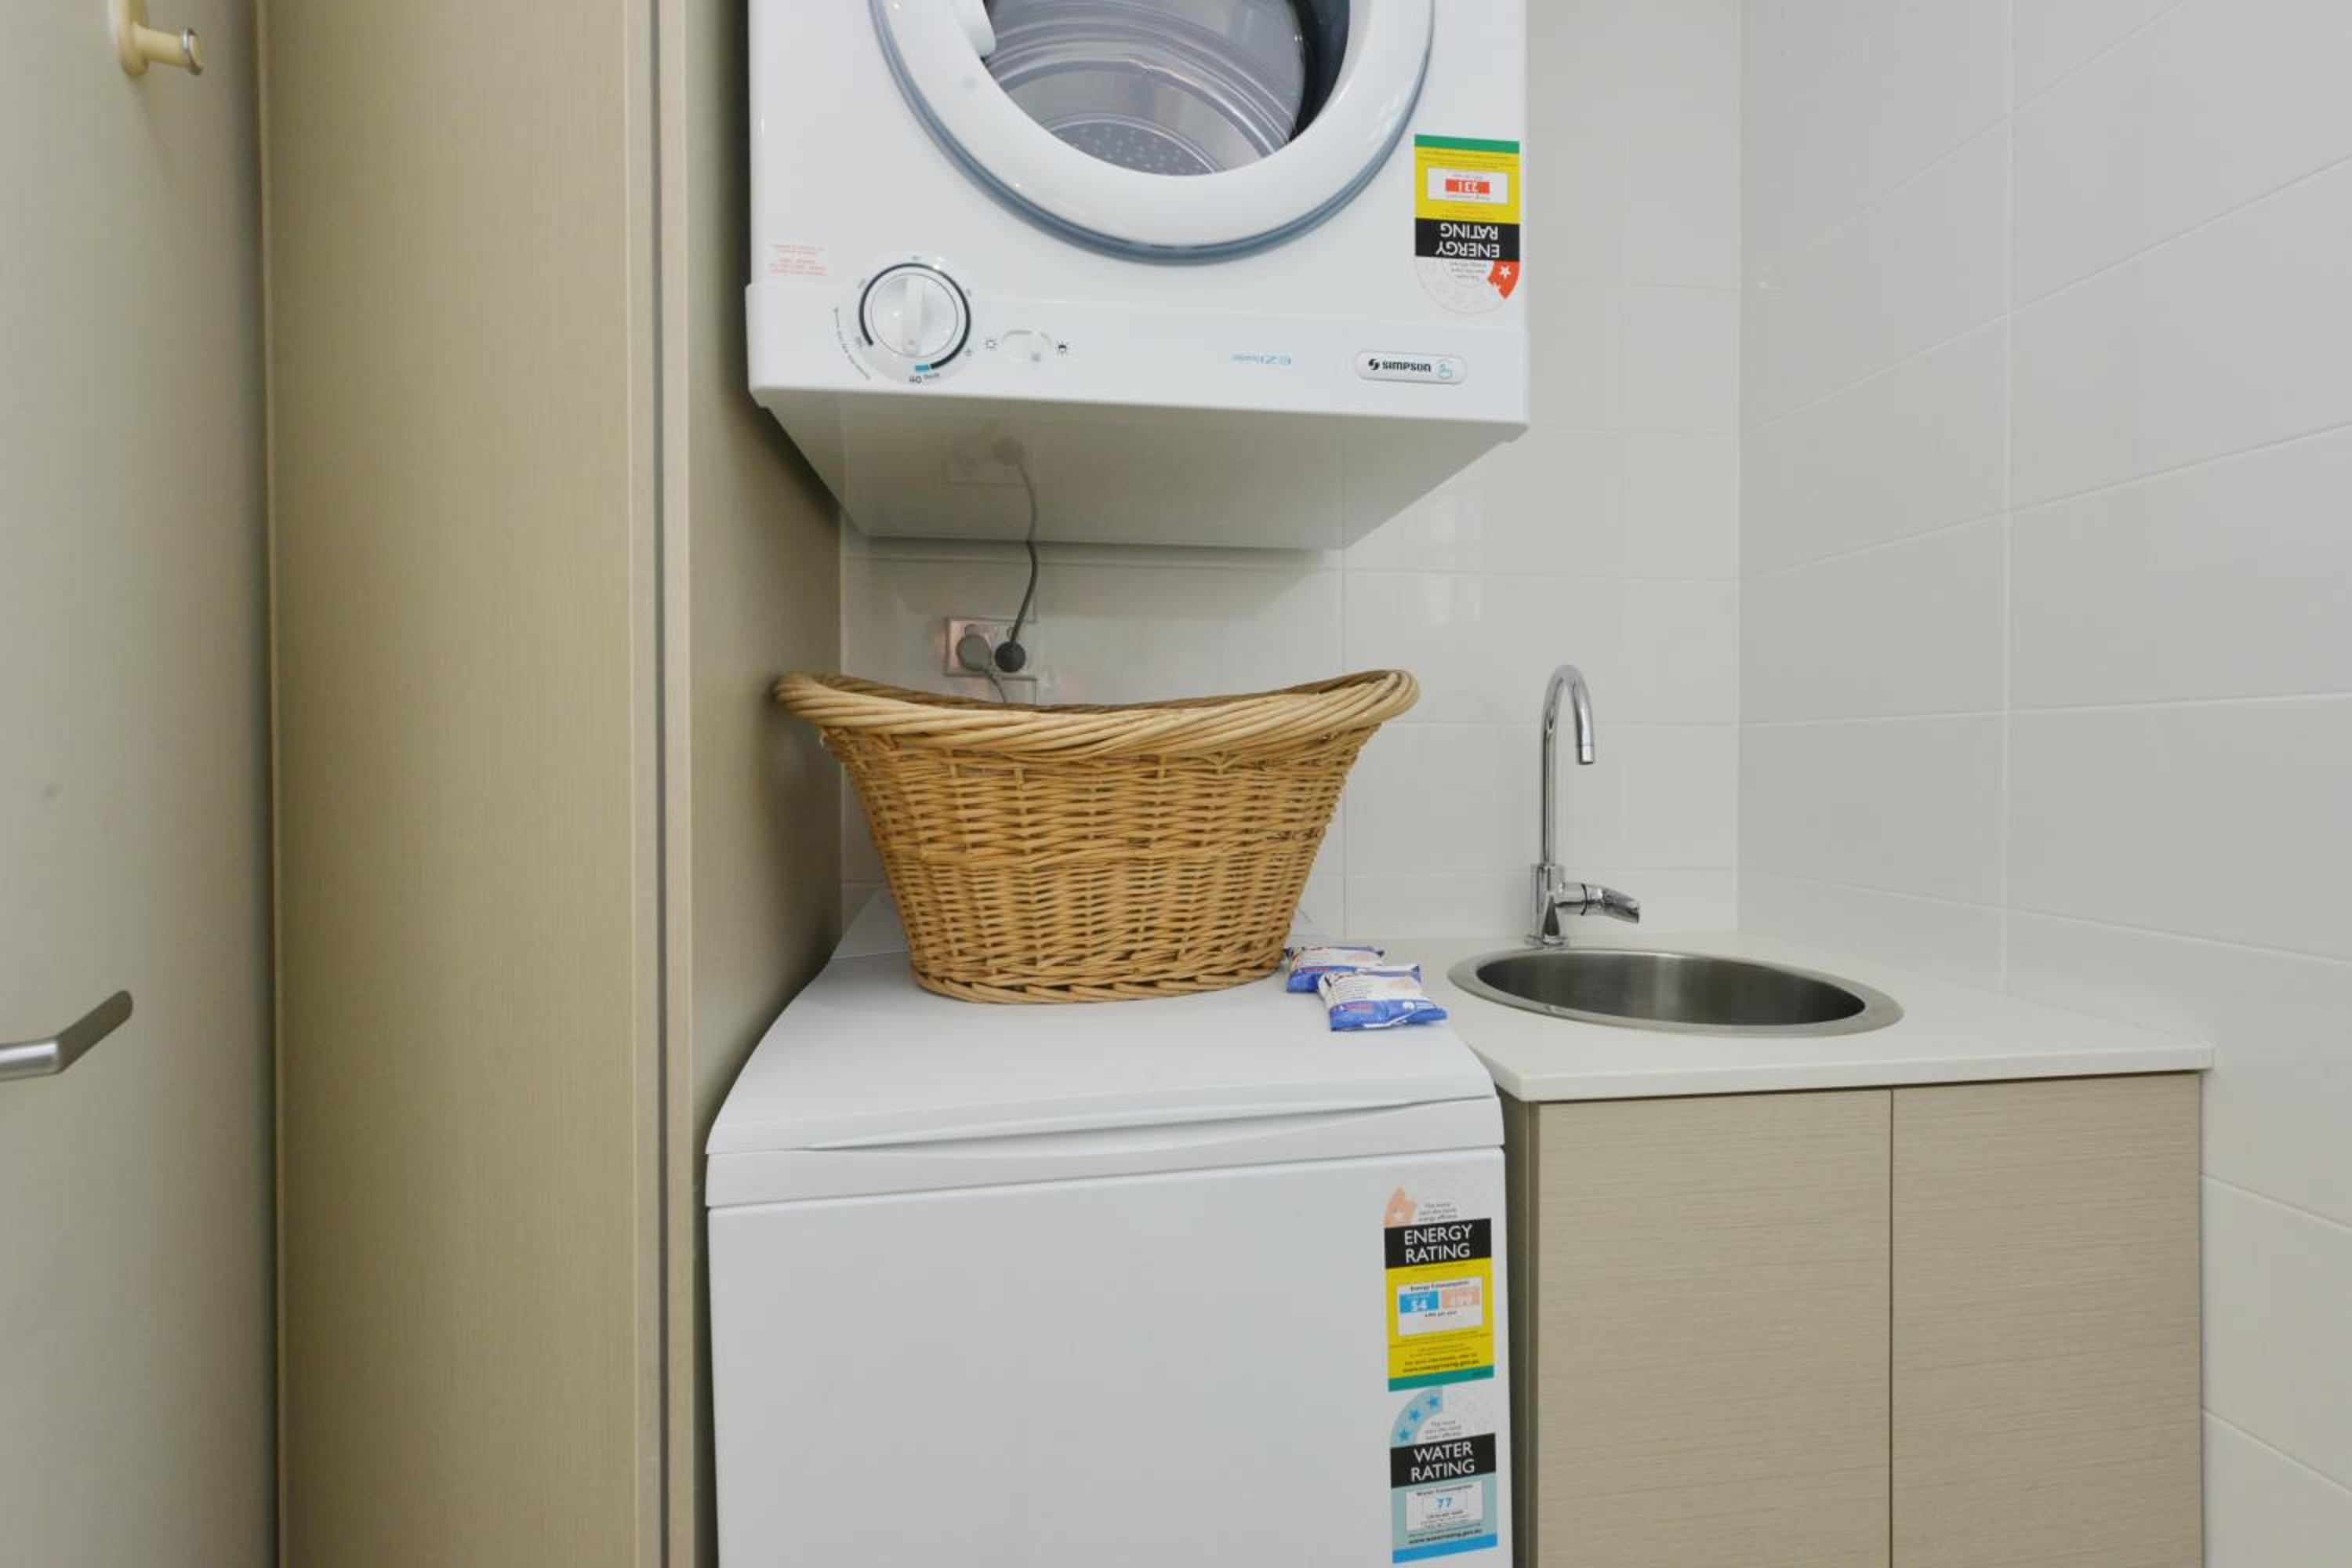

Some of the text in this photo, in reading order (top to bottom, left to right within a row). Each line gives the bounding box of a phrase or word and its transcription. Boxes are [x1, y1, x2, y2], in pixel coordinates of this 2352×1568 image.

[1440, 223, 1498, 241] RATING
[1435, 241, 1500, 259] ENERGY
[1404, 1224, 1472, 1245] ENERGY
[1406, 1243, 1470, 1263] RATING
[1414, 1441, 1473, 1463] WATER
[1411, 1459, 1475, 1482] RATING
[1437, 1497, 1453, 1508] 77
